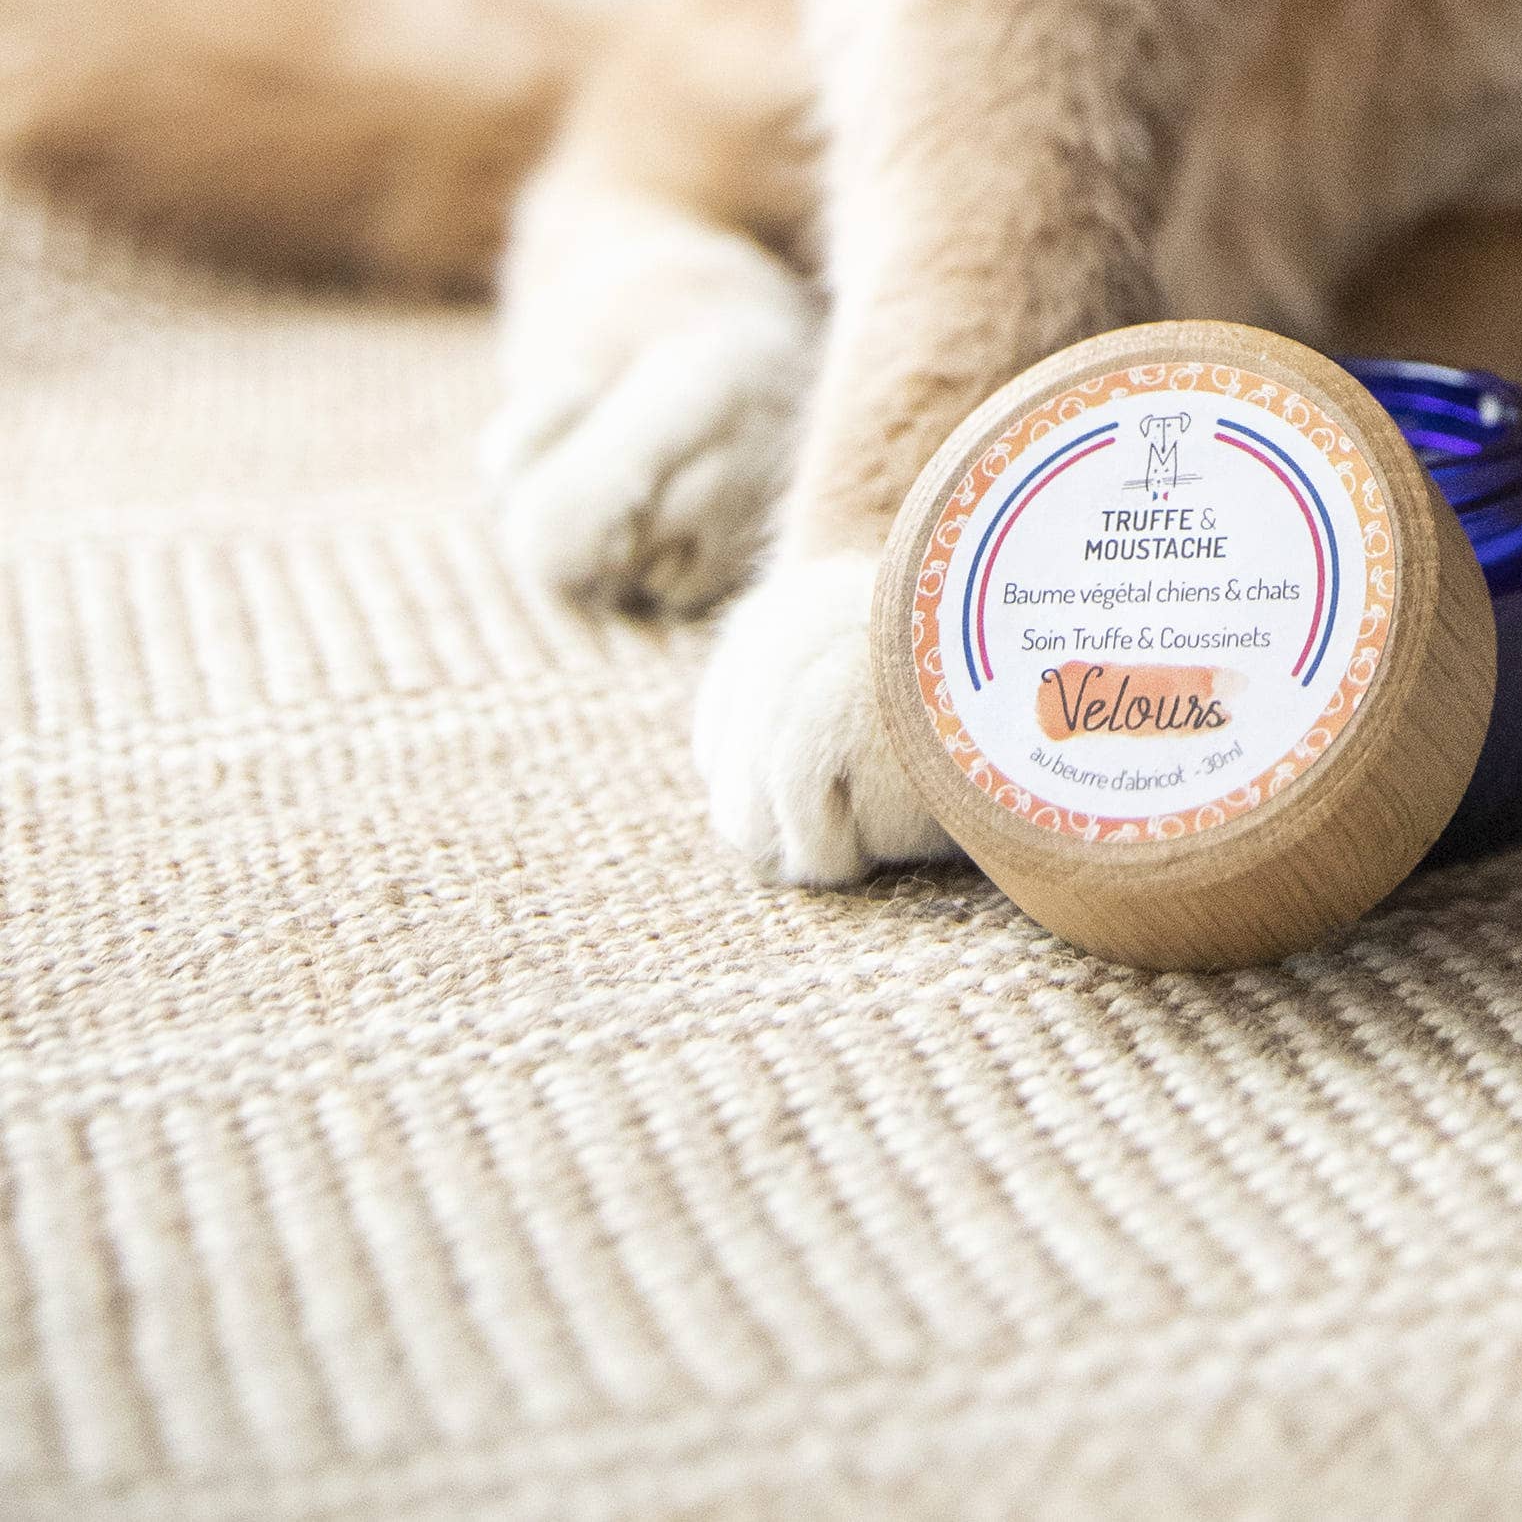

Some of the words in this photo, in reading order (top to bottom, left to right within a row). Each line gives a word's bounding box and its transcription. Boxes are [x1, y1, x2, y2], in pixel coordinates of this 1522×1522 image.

[1102, 509, 1193, 532] TRUFFE
[1199, 507, 1217, 530] &
[1085, 537, 1228, 561] MOUSTACHE
[1003, 582, 1076, 605] Baume
[1080, 581, 1152, 610] végétal
[1156, 580, 1220, 603] chiens
[1224, 578, 1241, 602] &
[1246, 578, 1300, 601] chats
[1021, 628, 1066, 651] Soin
[1073, 627, 1133, 650] Truffe
[1137, 627, 1154, 649] &
[1160, 625, 1271, 649] Coussinets
[1041, 665, 1226, 732] Velours
[1029, 745, 1053, 767] au
[1052, 754, 1109, 790] beurre
